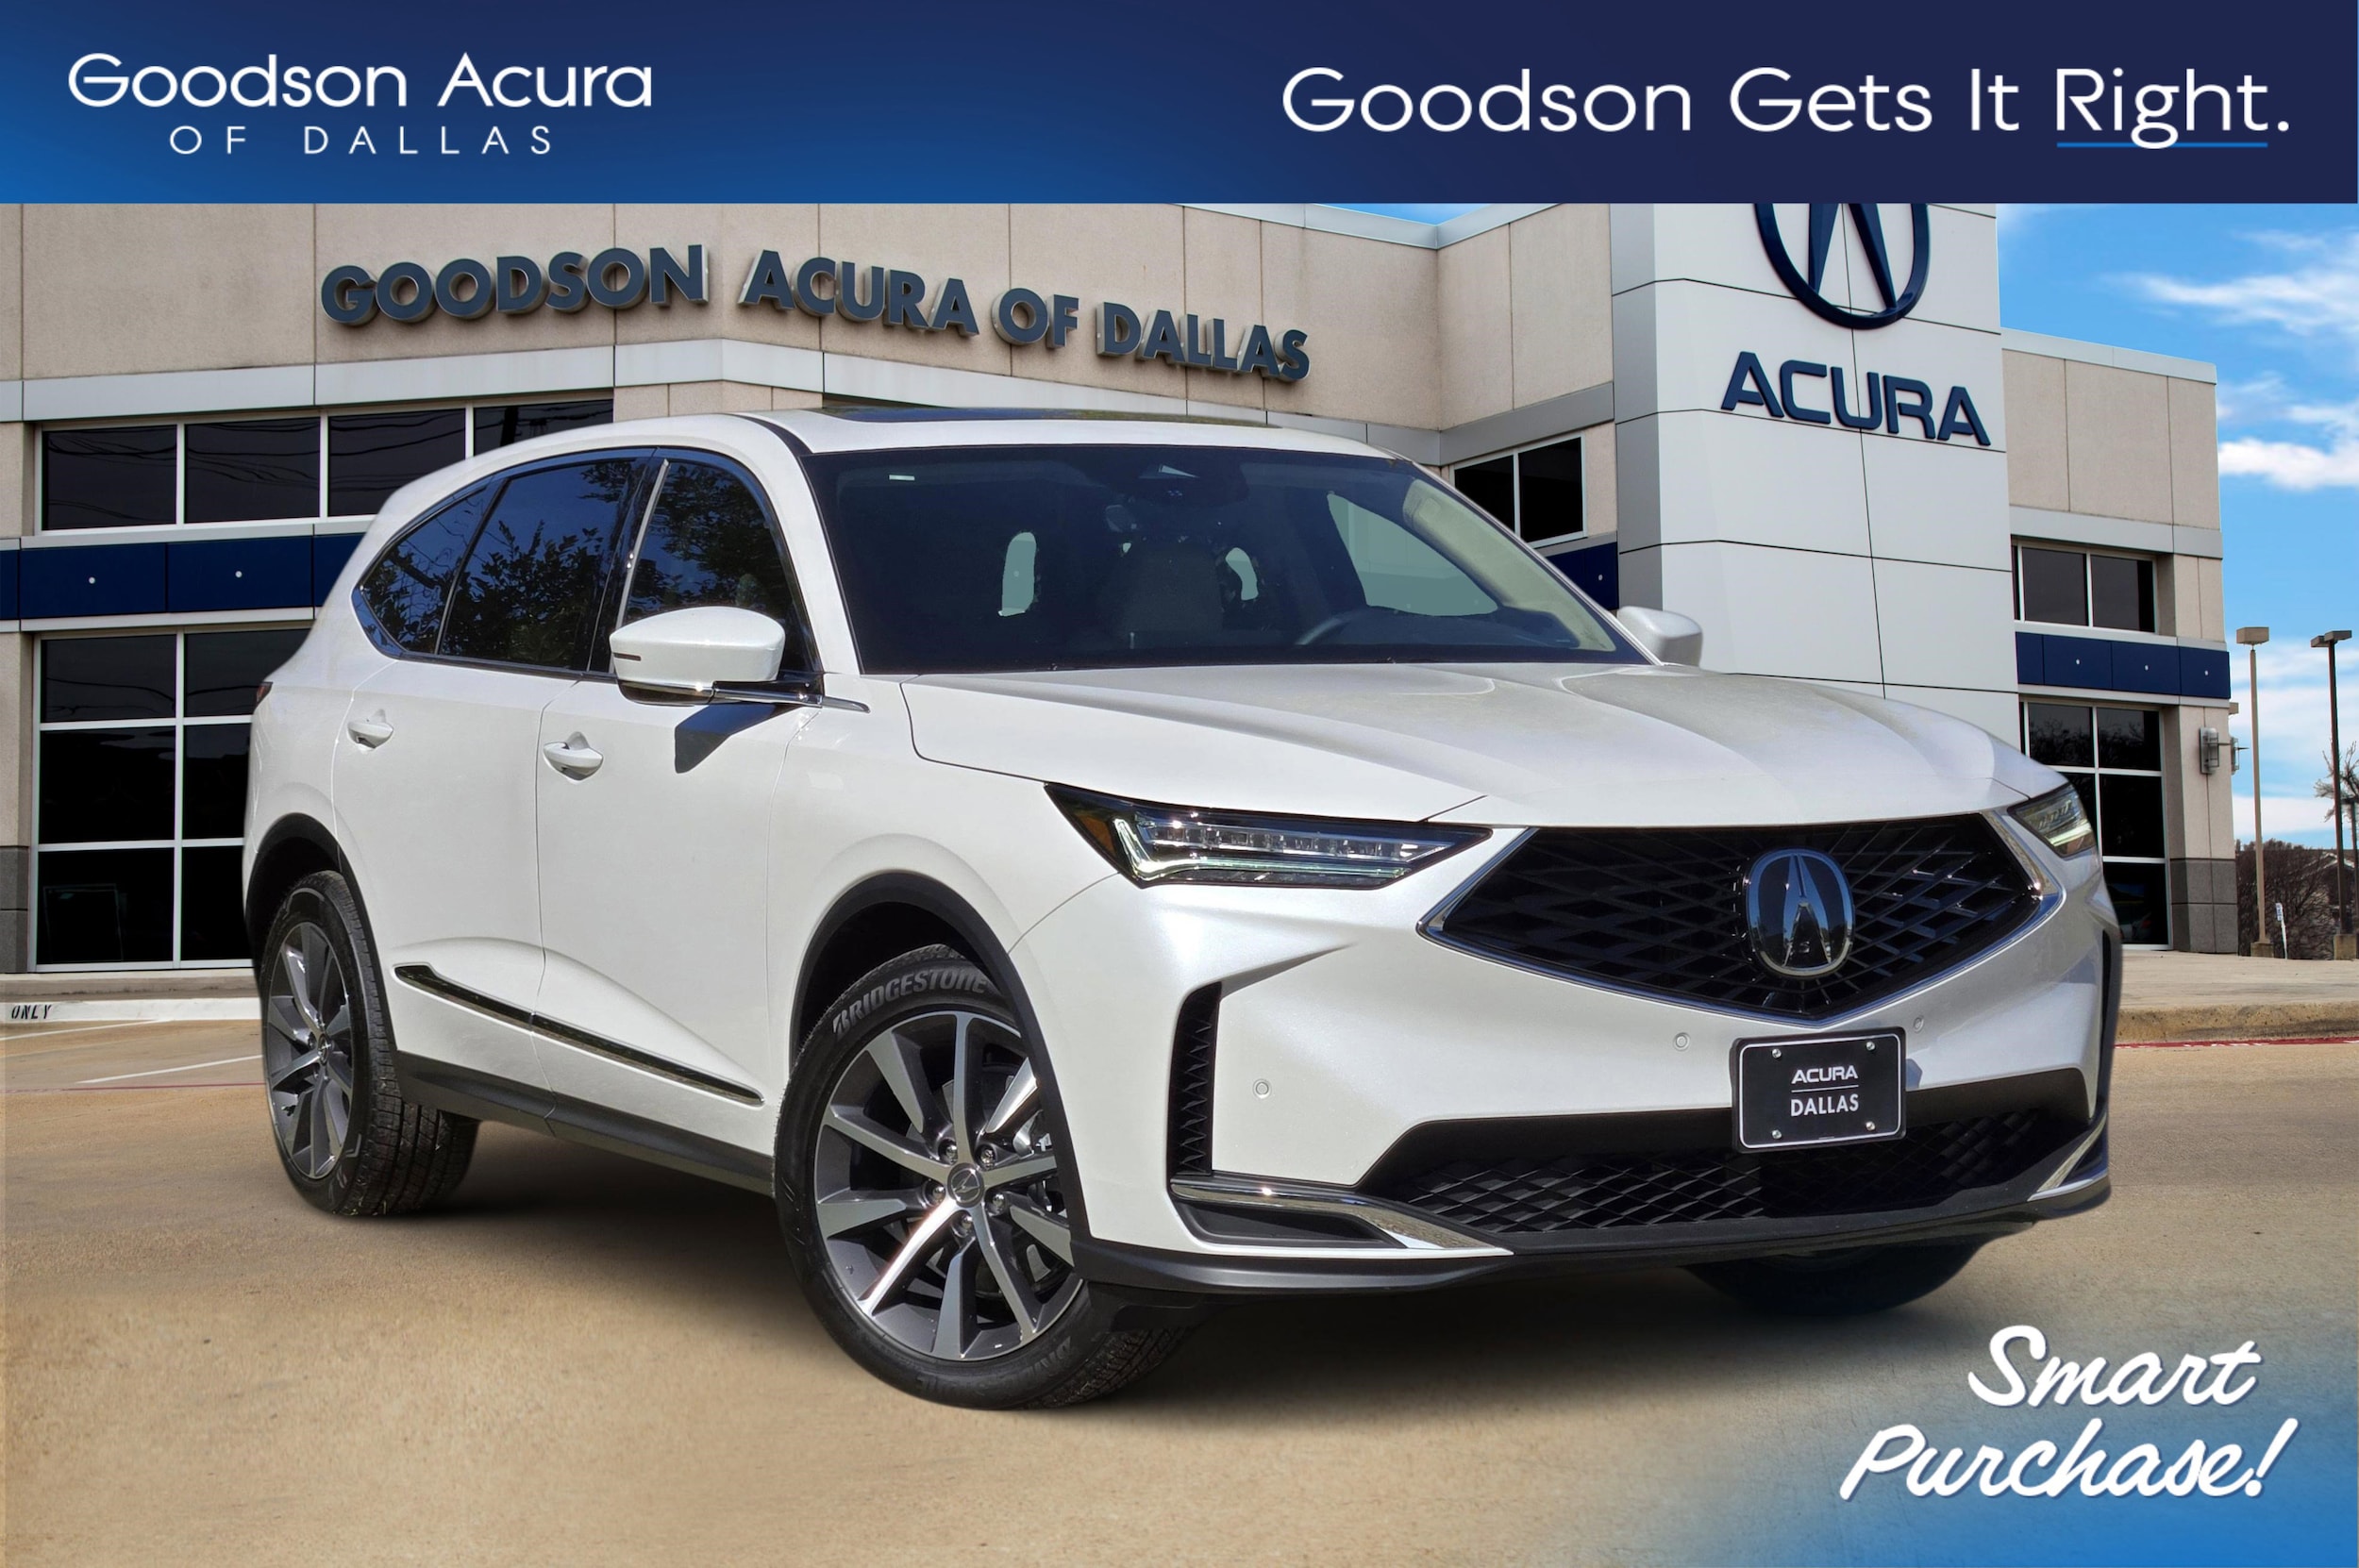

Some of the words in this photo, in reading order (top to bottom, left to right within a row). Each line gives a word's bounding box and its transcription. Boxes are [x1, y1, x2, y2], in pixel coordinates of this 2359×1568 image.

[321, 244, 708, 326] GOODSON
[739, 249, 979, 337] ACURA
[992, 287, 1079, 348] OF
[1096, 301, 1311, 382] DALLAS
[1720, 351, 1991, 446] ACURA
[11, 1004, 52, 1020] ONLY
[1791, 1064, 1859, 1084] ACURA
[1790, 1093, 1859, 1117] DALLAS
